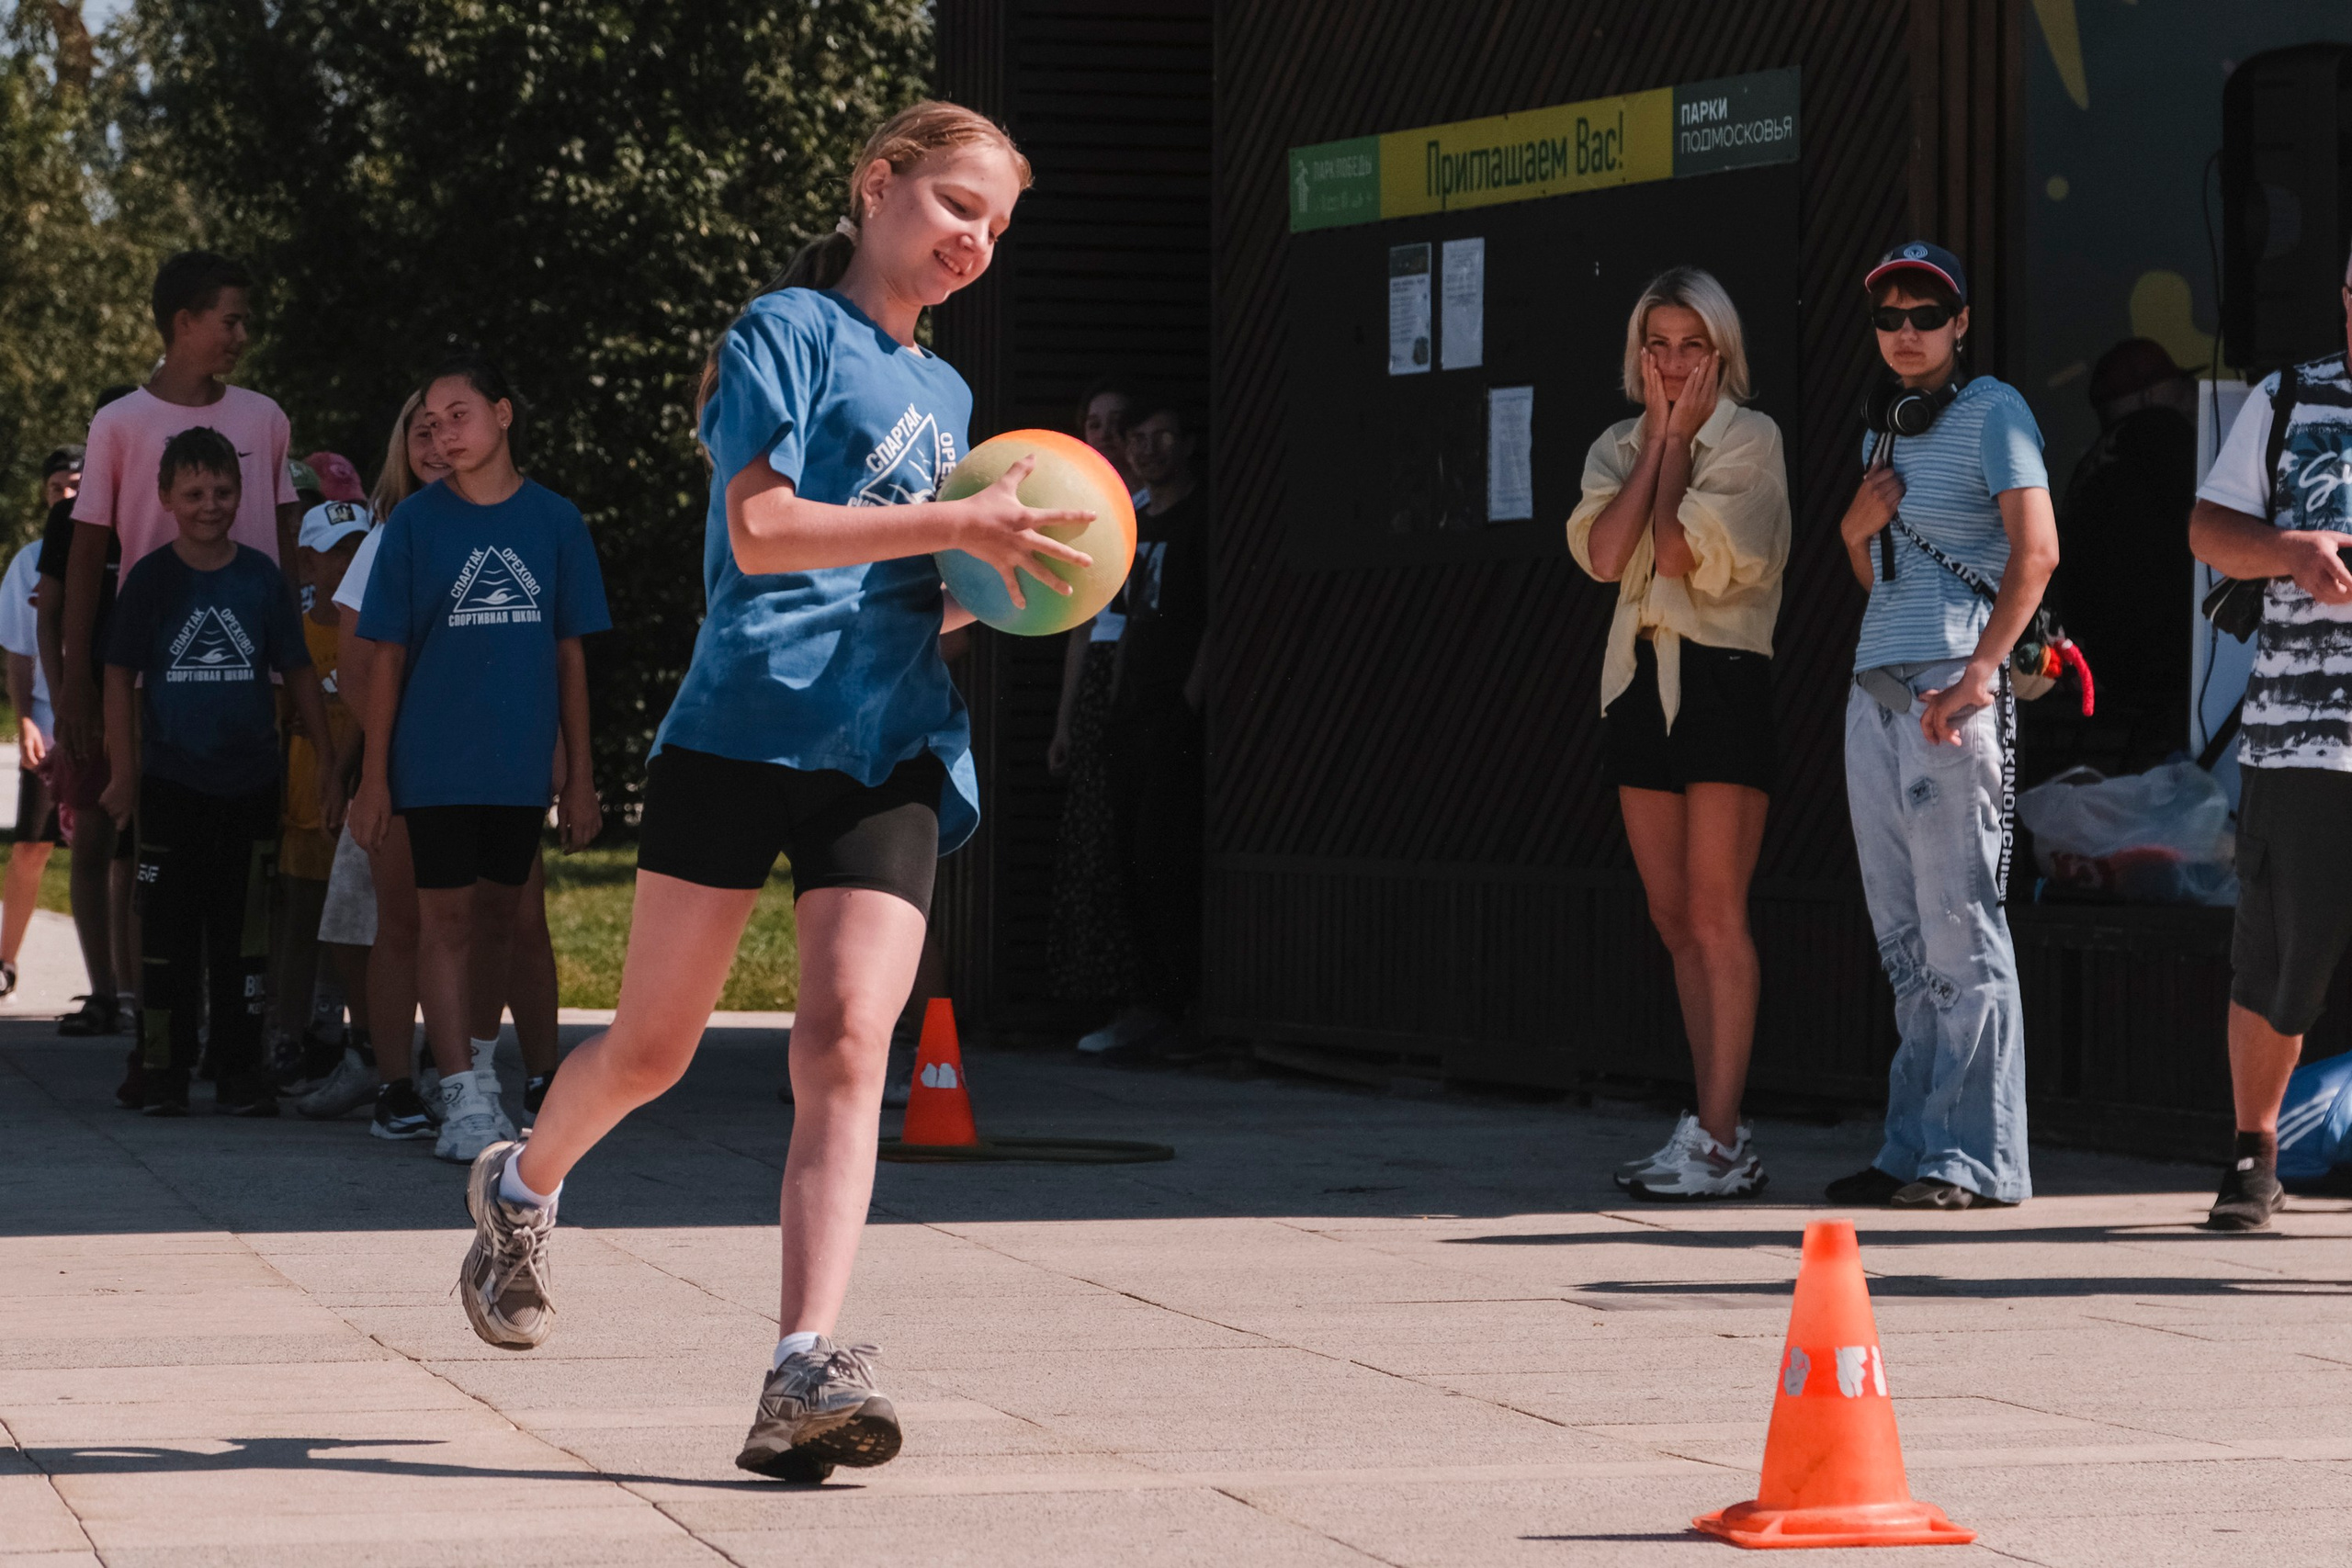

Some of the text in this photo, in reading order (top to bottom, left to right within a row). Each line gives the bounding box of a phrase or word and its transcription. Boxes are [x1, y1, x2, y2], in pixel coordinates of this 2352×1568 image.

[1681, 96, 1727, 127] ПАРКИ
[1681, 116, 1792, 154] ПОДМОСКОВЬЯ
[1426, 110, 1624, 212] Приглашаем Вас!
[865, 402, 923, 472] СПАРТАК
[940, 432, 957, 478] ОРЕ
[450, 547, 484, 599] СПАРТАК
[502, 547, 541, 596] ОРЕХОВО
[169, 607, 205, 656] СПАРТАК
[220, 608, 255, 656] ОРЕХОВО
[448, 610, 541, 627] СПОРТИВНАЯ ШКОЛА
[166, 669, 254, 682] СПОРТИВНАЯ ШКОЛА
